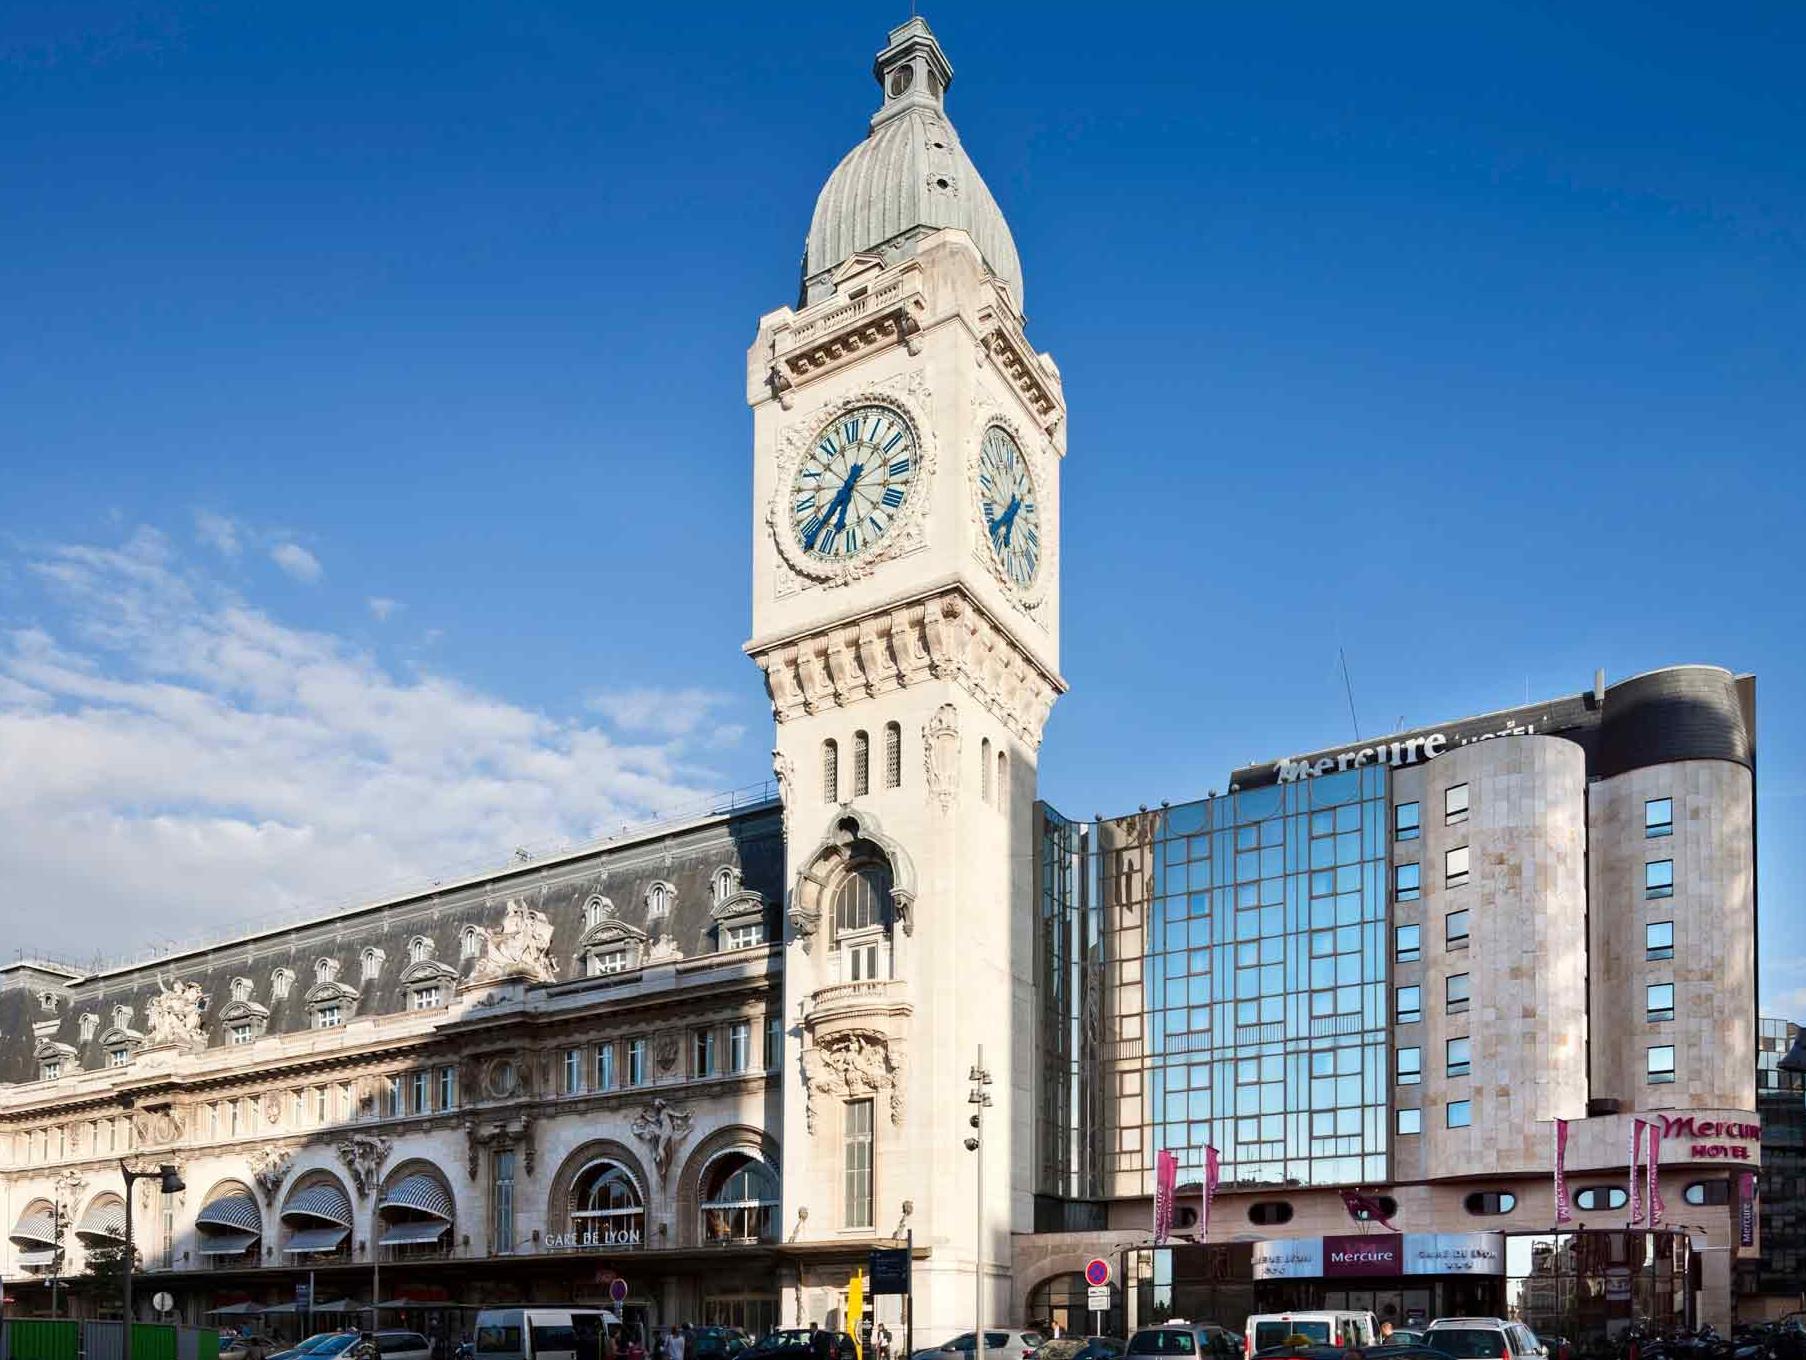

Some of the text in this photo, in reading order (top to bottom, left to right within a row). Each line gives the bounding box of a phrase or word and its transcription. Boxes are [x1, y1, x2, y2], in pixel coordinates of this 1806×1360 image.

[844, 418, 860, 444] XII
[869, 418, 881, 441] I
[882, 431, 904, 455] II
[889, 458, 910, 477] III
[881, 487, 905, 508] IIII
[1274, 733, 1447, 784] Mercure
[1658, 1114, 1761, 1142] Mercur
[1692, 1144, 1751, 1160] HOTEL
[1742, 1203, 1751, 1242] Mercure
[545, 1229, 640, 1247] GARE DE LYON
[1331, 1251, 1393, 1263] Mercure
